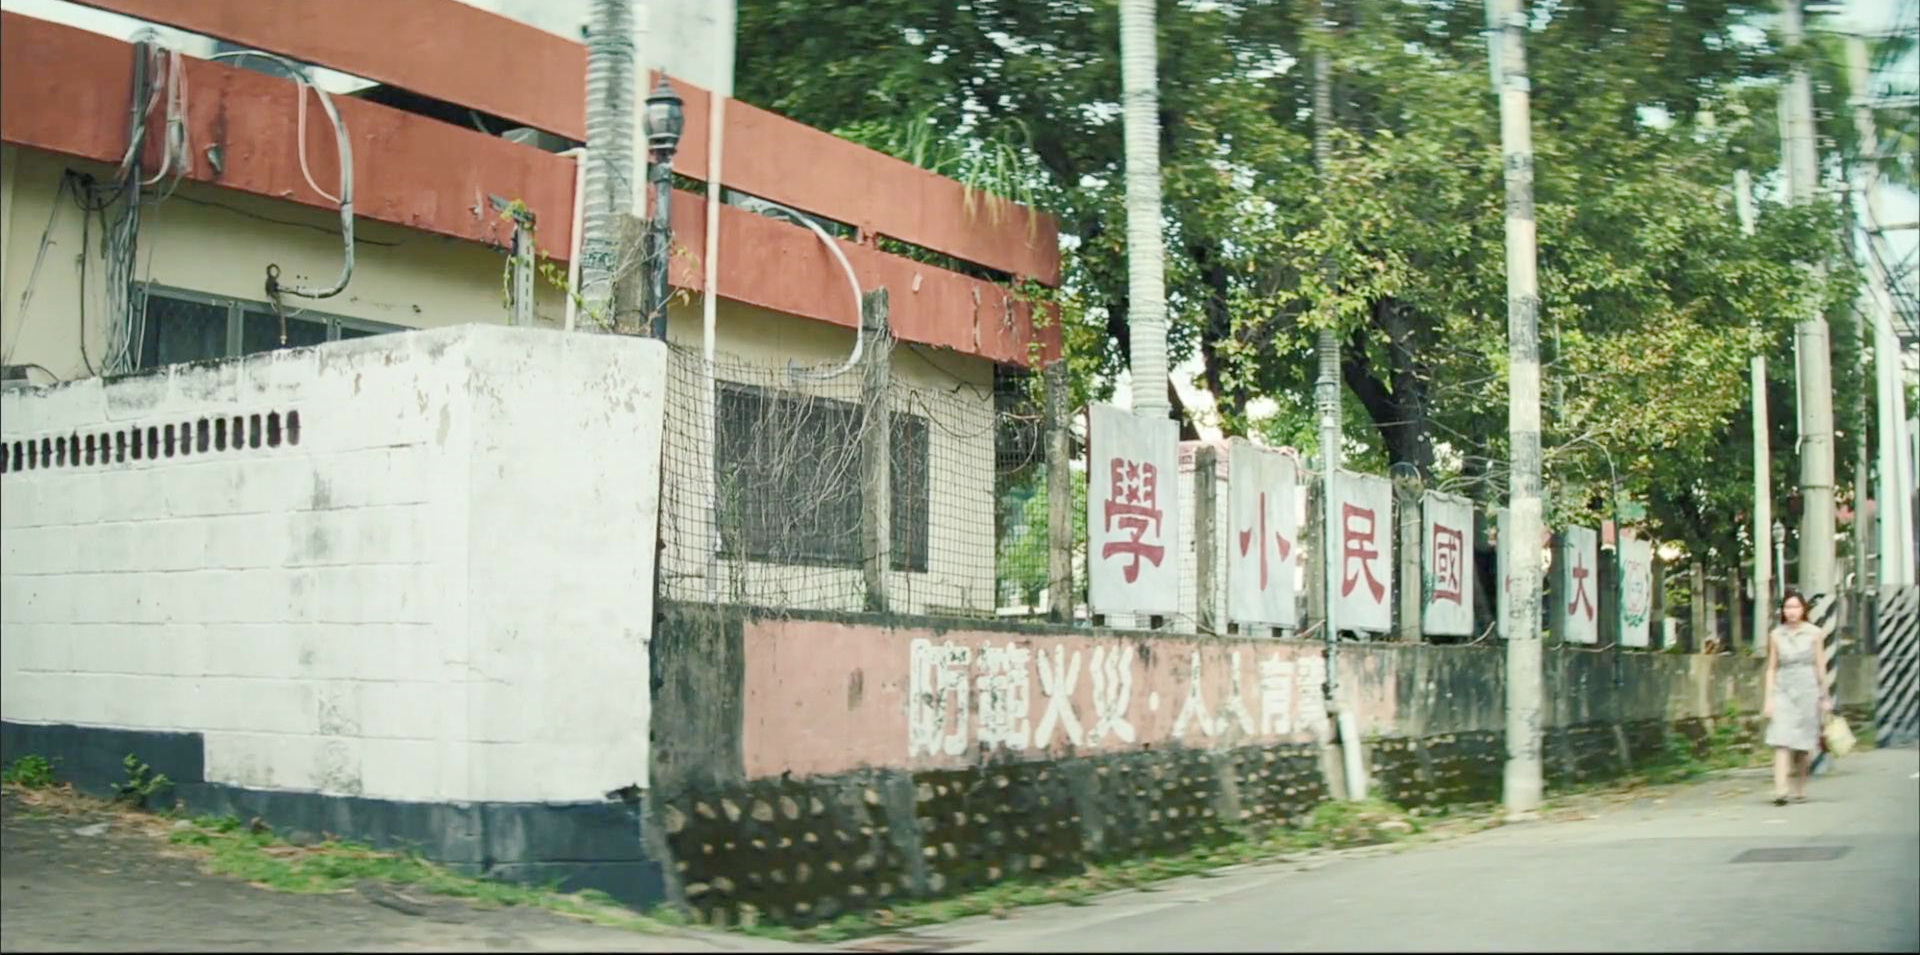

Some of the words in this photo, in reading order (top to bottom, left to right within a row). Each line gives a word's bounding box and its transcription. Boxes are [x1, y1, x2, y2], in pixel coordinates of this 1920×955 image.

[1102, 458, 1164, 583] 學
[1240, 492, 1290, 591] 小
[1342, 503, 1385, 604] 民
[1433, 524, 1462, 606] 國
[1568, 551, 1594, 621] 大
